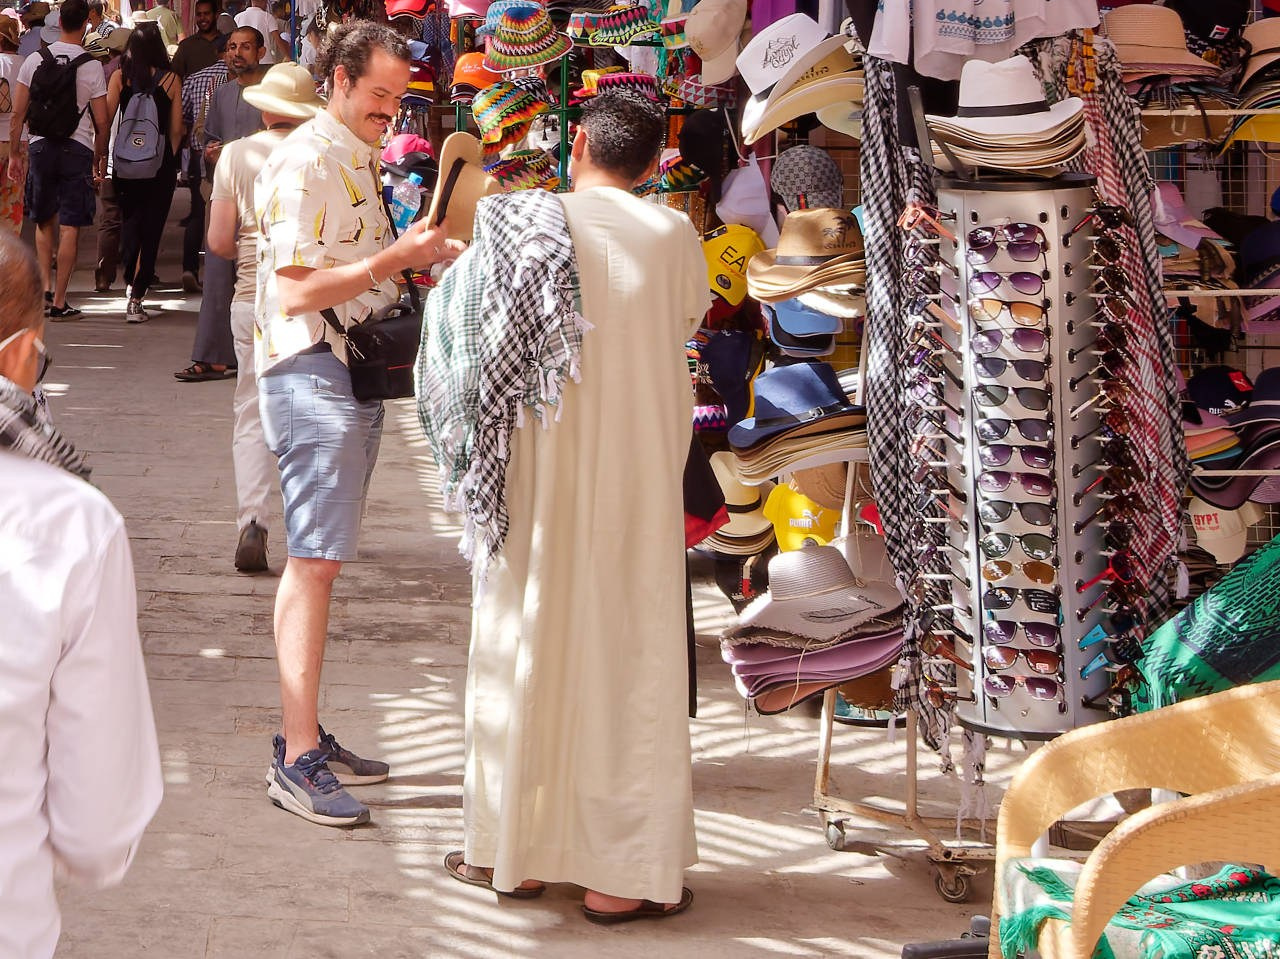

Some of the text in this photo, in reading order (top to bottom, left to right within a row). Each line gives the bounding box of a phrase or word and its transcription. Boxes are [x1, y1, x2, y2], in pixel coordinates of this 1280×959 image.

[720, 245, 746, 273] EA
[1208, 407, 1221, 416] PU
[789, 518, 812, 528] PUMA
